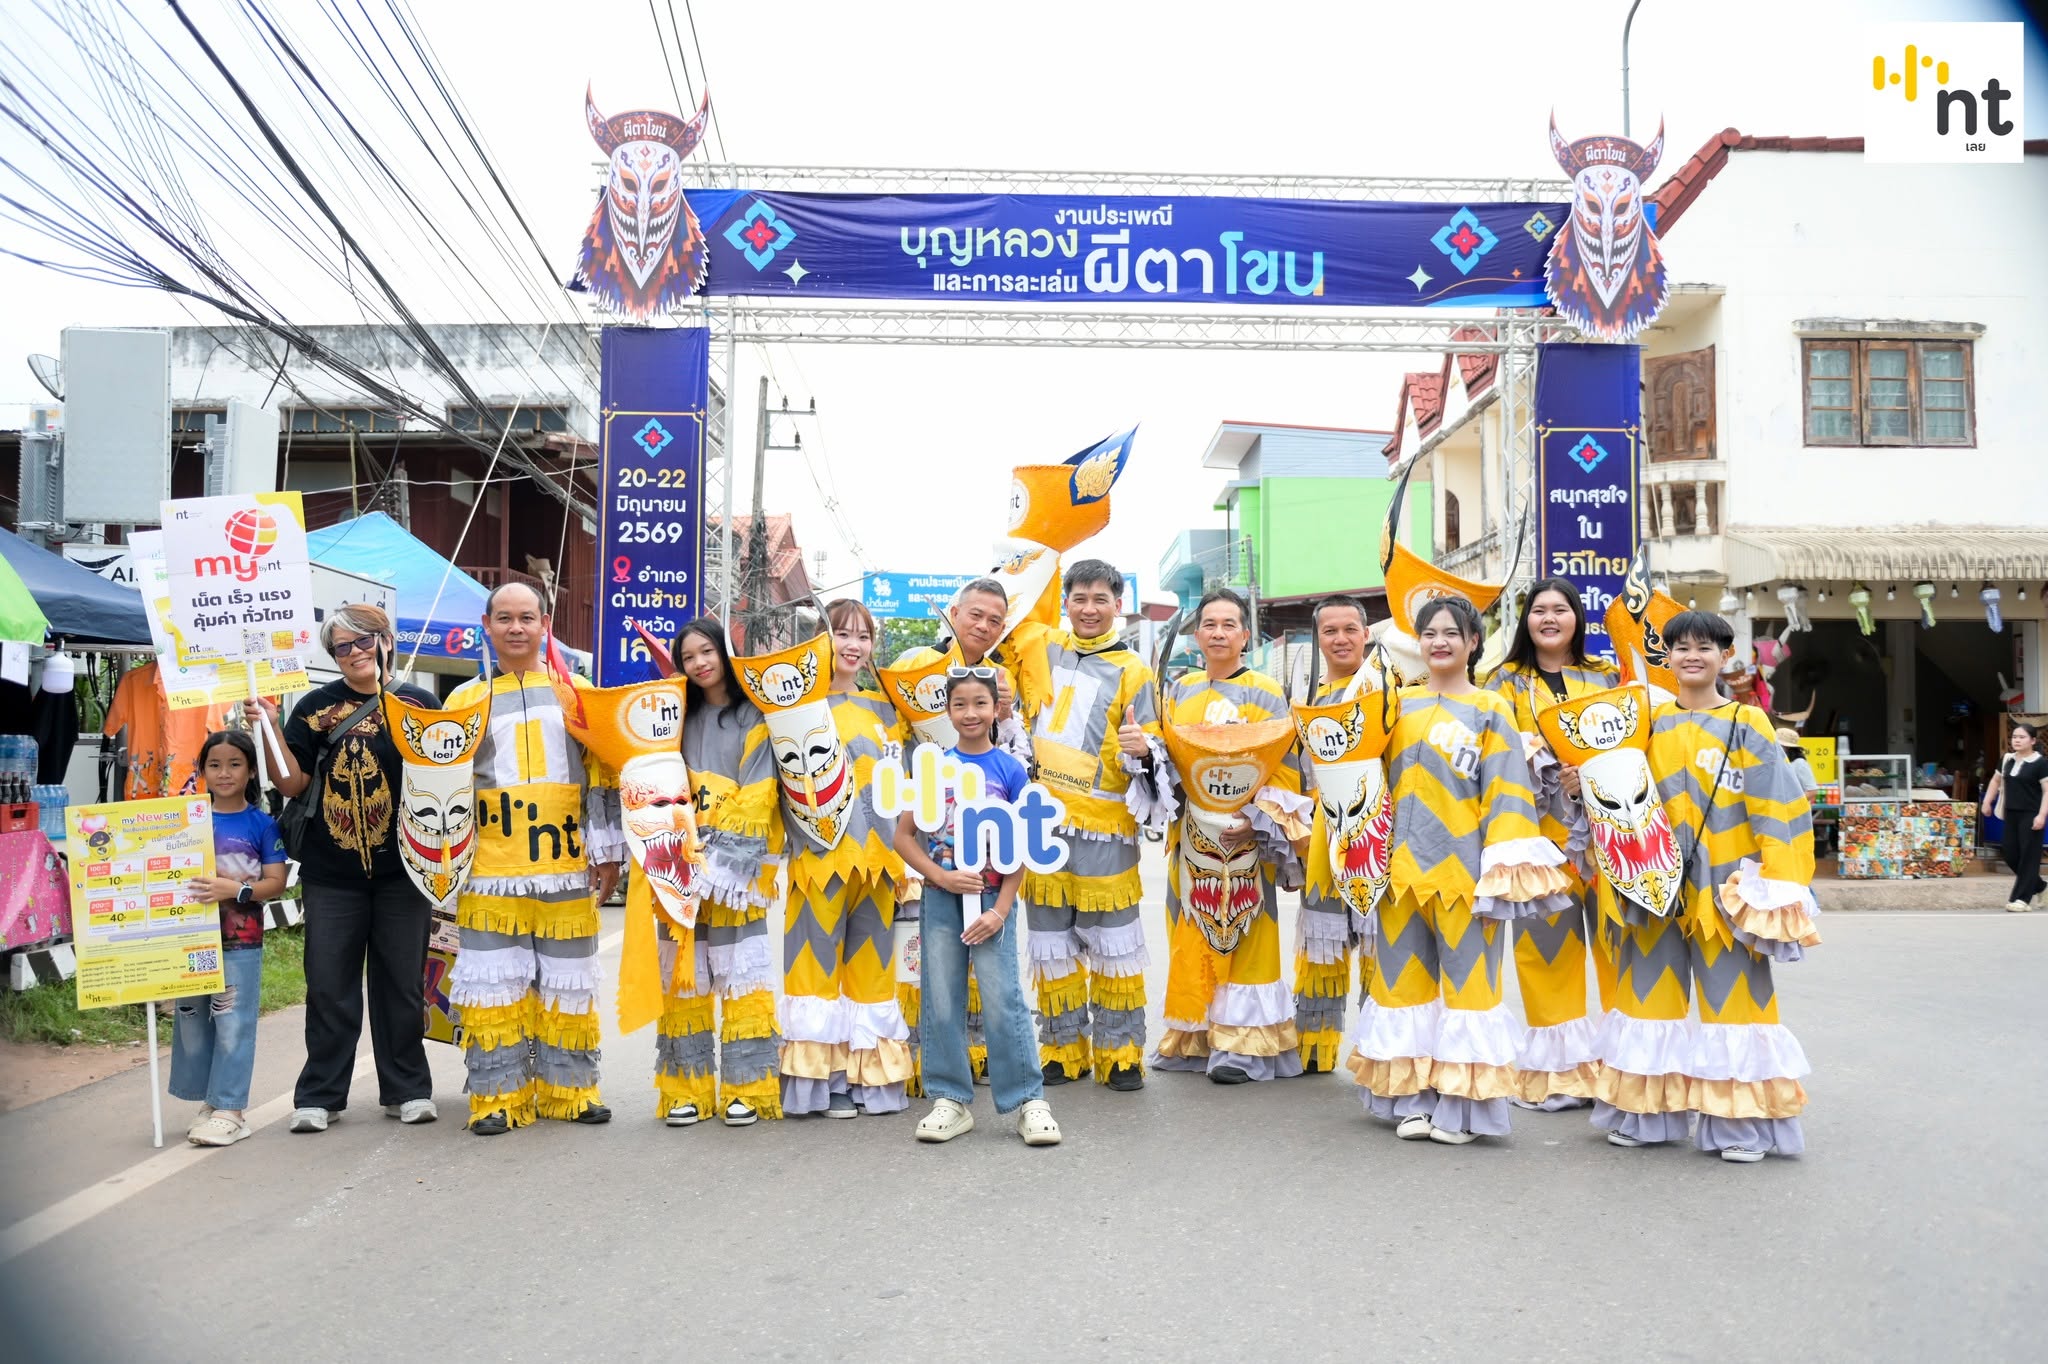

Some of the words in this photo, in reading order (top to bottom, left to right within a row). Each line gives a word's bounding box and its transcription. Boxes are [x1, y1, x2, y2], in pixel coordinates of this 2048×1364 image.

[623, 119, 667, 138] ผีตาโขน
[1585, 143, 1627, 163] ผีตาโขน
[1054, 203, 1174, 226] งานประเพณี
[901, 226, 1078, 269] บุญหลวง
[1083, 228, 1324, 297] ผีตาโขน
[933, 268, 1078, 293] และการละเล่น
[618, 468, 686, 488] 20-22
[616, 495, 687, 517] มิถุนายน
[1550, 484, 1628, 509] สนุกสุขใจ
[618, 522, 683, 543] 2569
[1576, 515, 1602, 539] ใน
[194, 555, 258, 582] my
[268, 559, 282, 571] nt
[1552, 550, 1628, 576] วิถีไทย
[111, 566, 139, 582] AI
[638, 567, 687, 583] อำเภอ
[192, 591, 222, 607] เน็ต
[228, 588, 253, 604] เร็ว
[259, 588, 291, 600] แรง
[612, 586, 687, 608] ด่านซ้าย
[193, 611, 236, 631] คุ้มค่า
[242, 606, 294, 623] ทั่วไทย
[622, 615, 675, 632] จังหวัด
[397, 630, 441, 645] some
[445, 625, 482, 654] est
[782, 675, 802, 691] nt
[777, 692, 796, 702] loei
[662, 703, 678, 721] nt
[653, 723, 671, 737] loei
[1602, 716, 1624, 732] nt
[444, 736, 462, 749] nt
[1325, 732, 1345, 747] nt
[1595, 735, 1617, 746] loei
[434, 750, 453, 759] loei
[1319, 747, 1338, 757] loei
[1042, 768, 1091, 788] BROADBAND
[1209, 783, 1231, 795] nt
[122, 817, 135, 825] my
[136, 812, 162, 822] New
[163, 812, 180, 820] SIM
[529, 814, 580, 862] nt
[962, 791, 1062, 866] nt
[124, 864, 132, 873] 4
[184, 857, 192, 867] 4
